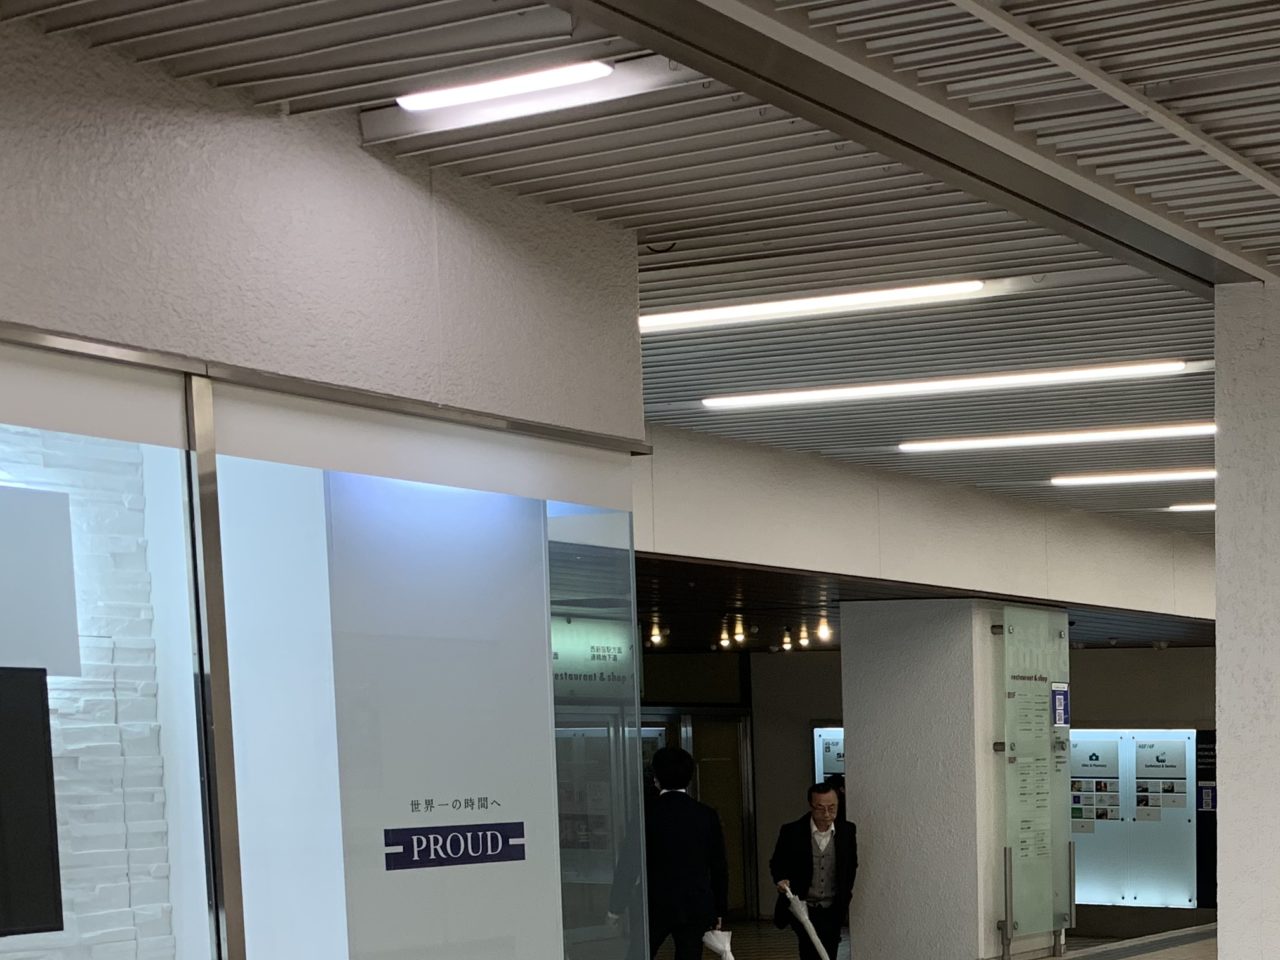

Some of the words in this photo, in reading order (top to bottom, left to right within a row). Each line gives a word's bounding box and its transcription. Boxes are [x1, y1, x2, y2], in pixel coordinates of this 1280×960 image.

[599, 672, 606, 681] &
[607, 672, 627, 683] shop
[410, 797, 502, 812] 世界一の時間へ
[411, 830, 503, 861] PROUD
